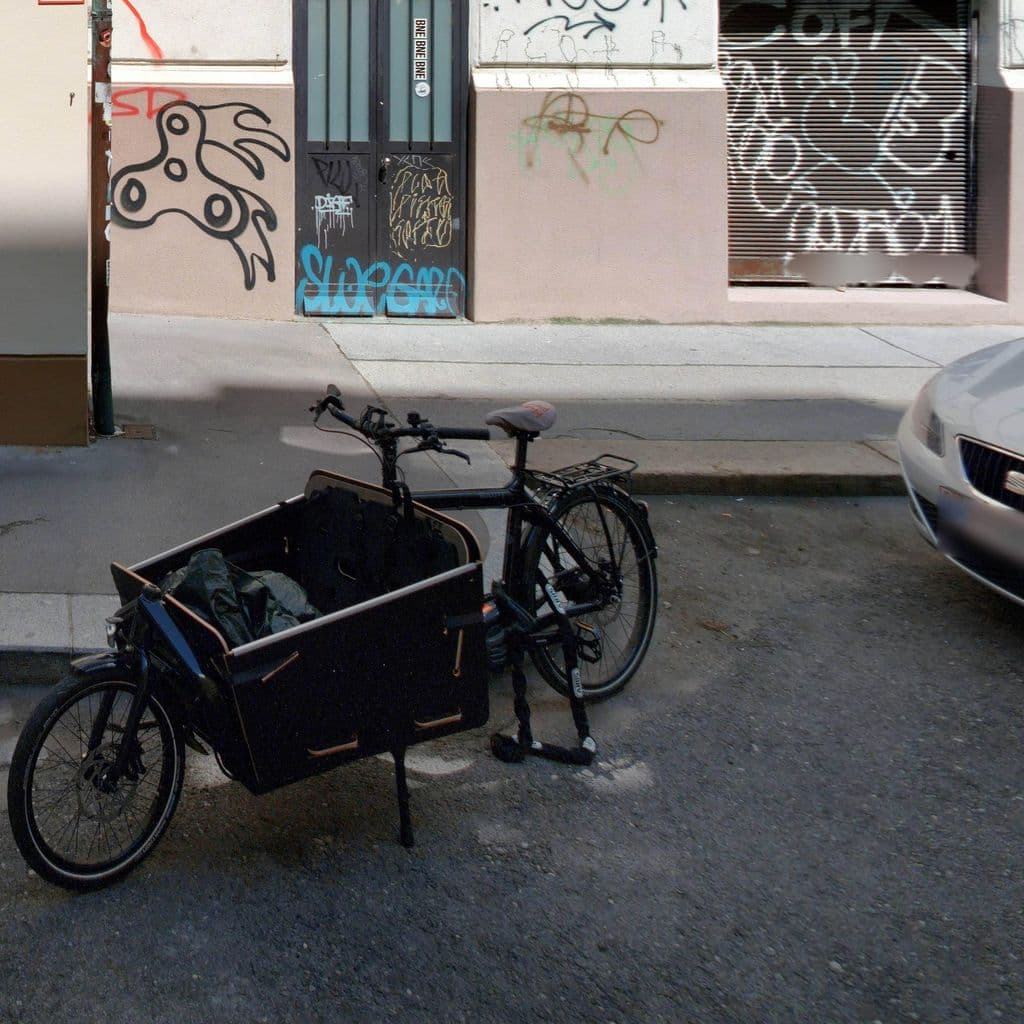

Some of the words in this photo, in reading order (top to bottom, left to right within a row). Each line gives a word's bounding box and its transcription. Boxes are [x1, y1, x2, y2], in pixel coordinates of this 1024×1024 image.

[415, 19, 426, 38] BNE
[415, 40, 426, 59] BNE
[415, 61, 426, 79] BNE
